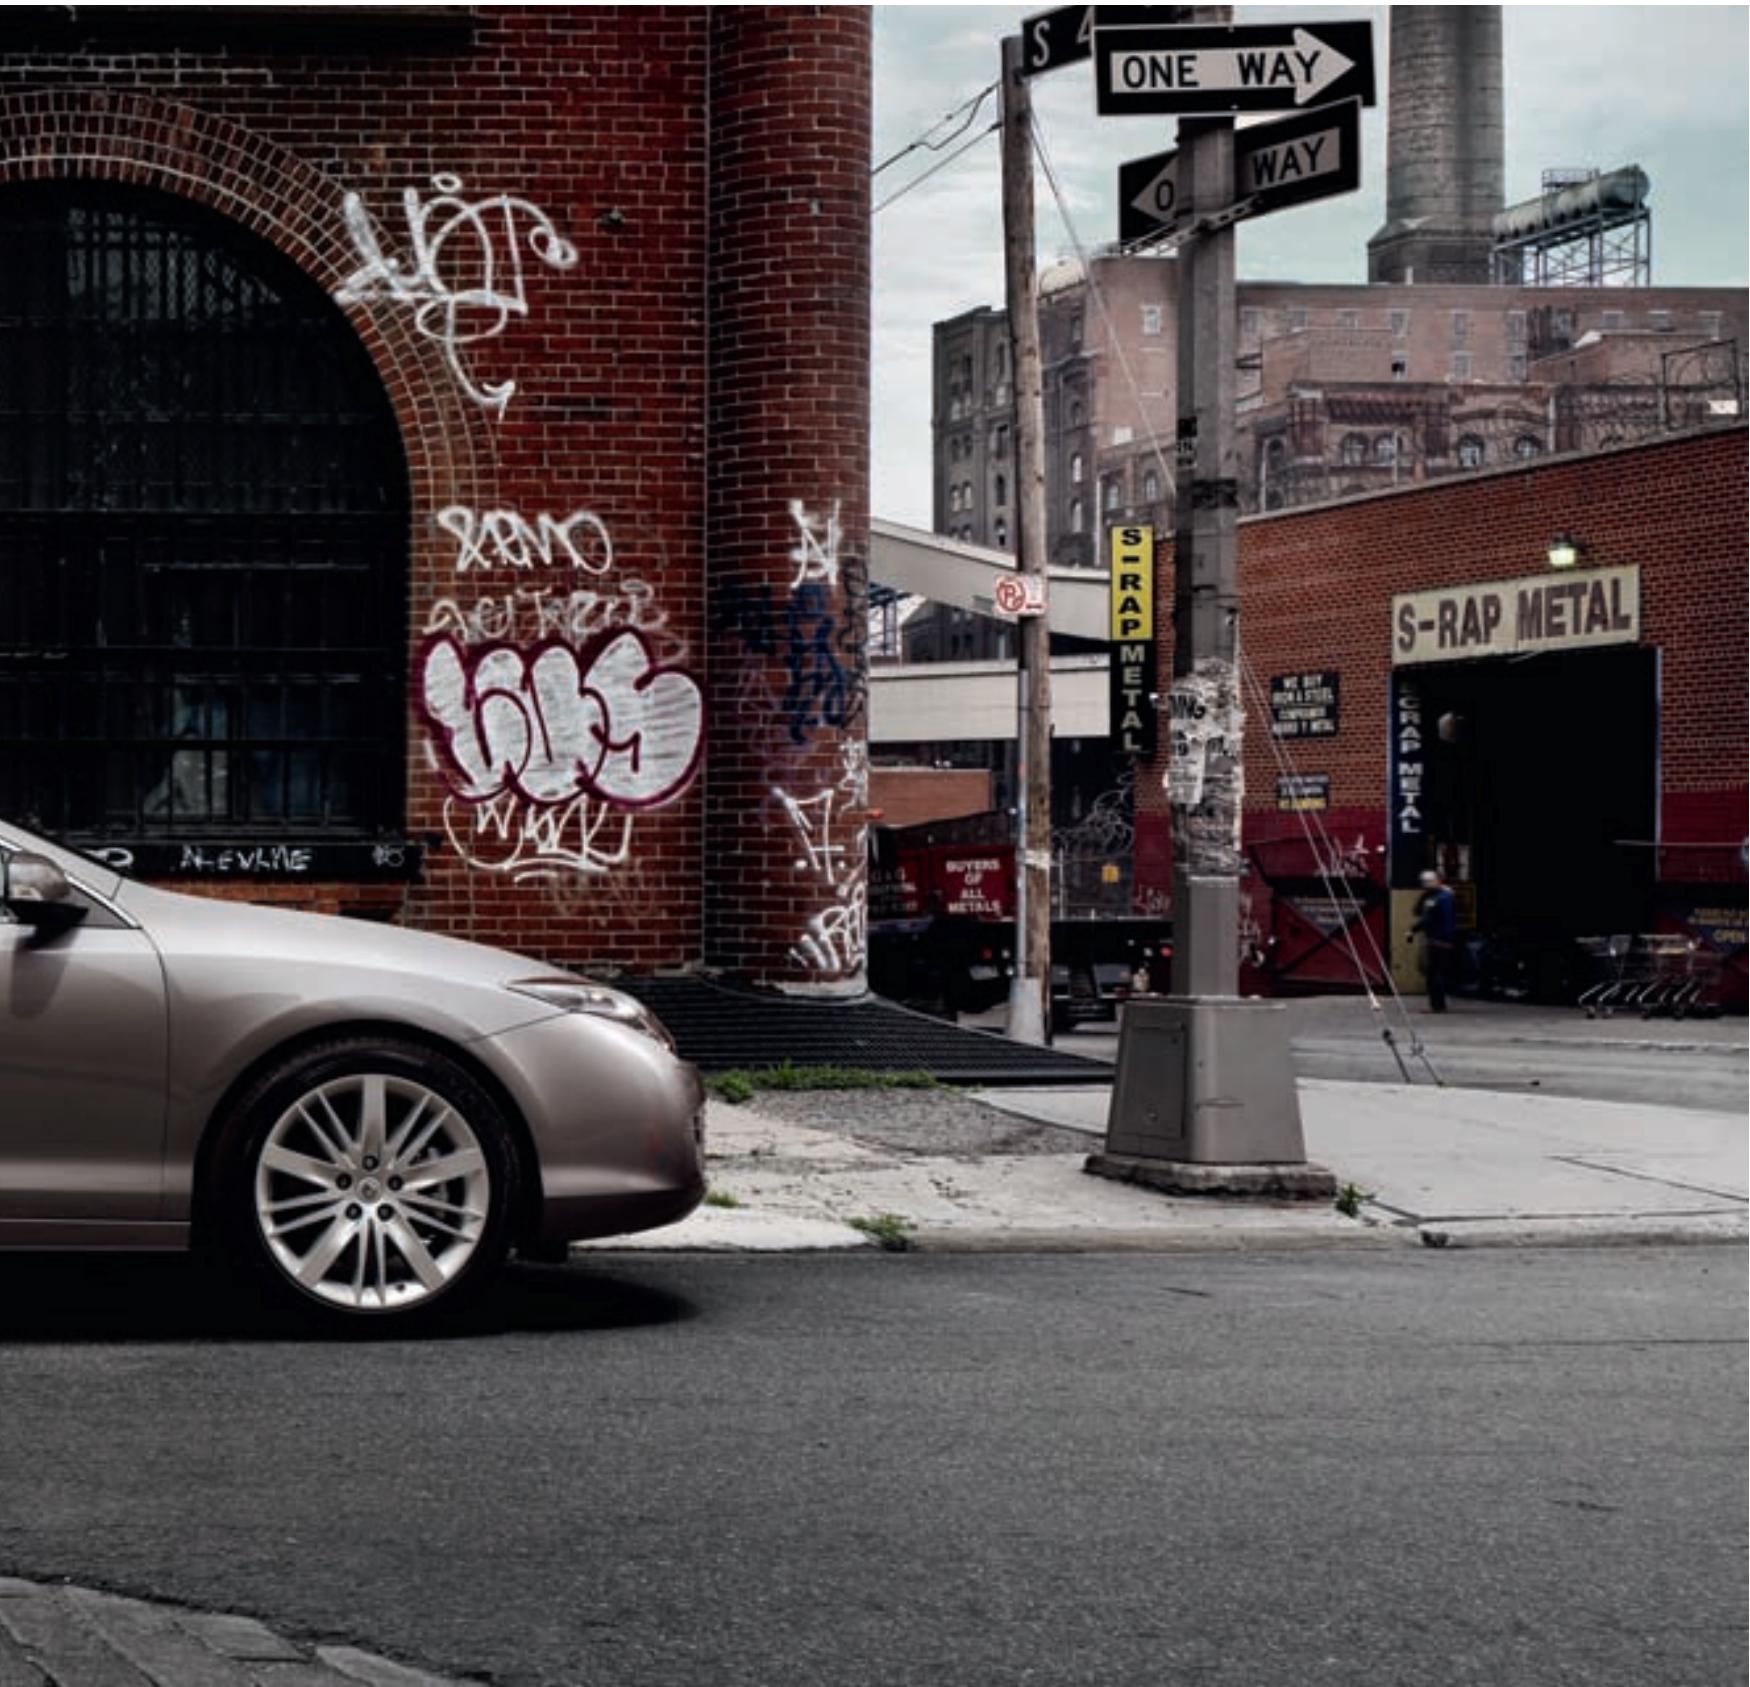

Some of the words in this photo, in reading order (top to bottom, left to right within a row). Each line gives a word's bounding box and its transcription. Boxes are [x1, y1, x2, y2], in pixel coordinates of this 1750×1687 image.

[1030, 19, 1052, 68] S
[1122, 54, 1199, 88] ONE
[1236, 51, 1321, 85] WAY
[1253, 136, 1326, 186] WAY
[1118, 528, 1143, 636] S-RAP
[1397, 594, 1502, 653] S-RAP
[1516, 577, 1632, 641] METAL
[1119, 644, 1145, 750] METAL
[1398, 690, 1422, 755] CRAP
[1398, 762, 1424, 834] METAL
[945, 859, 1000, 872] BUYERS
[964, 872, 983, 886] OF
[948, 900, 1000, 914] METALS
[961, 887, 985, 899] ALL
